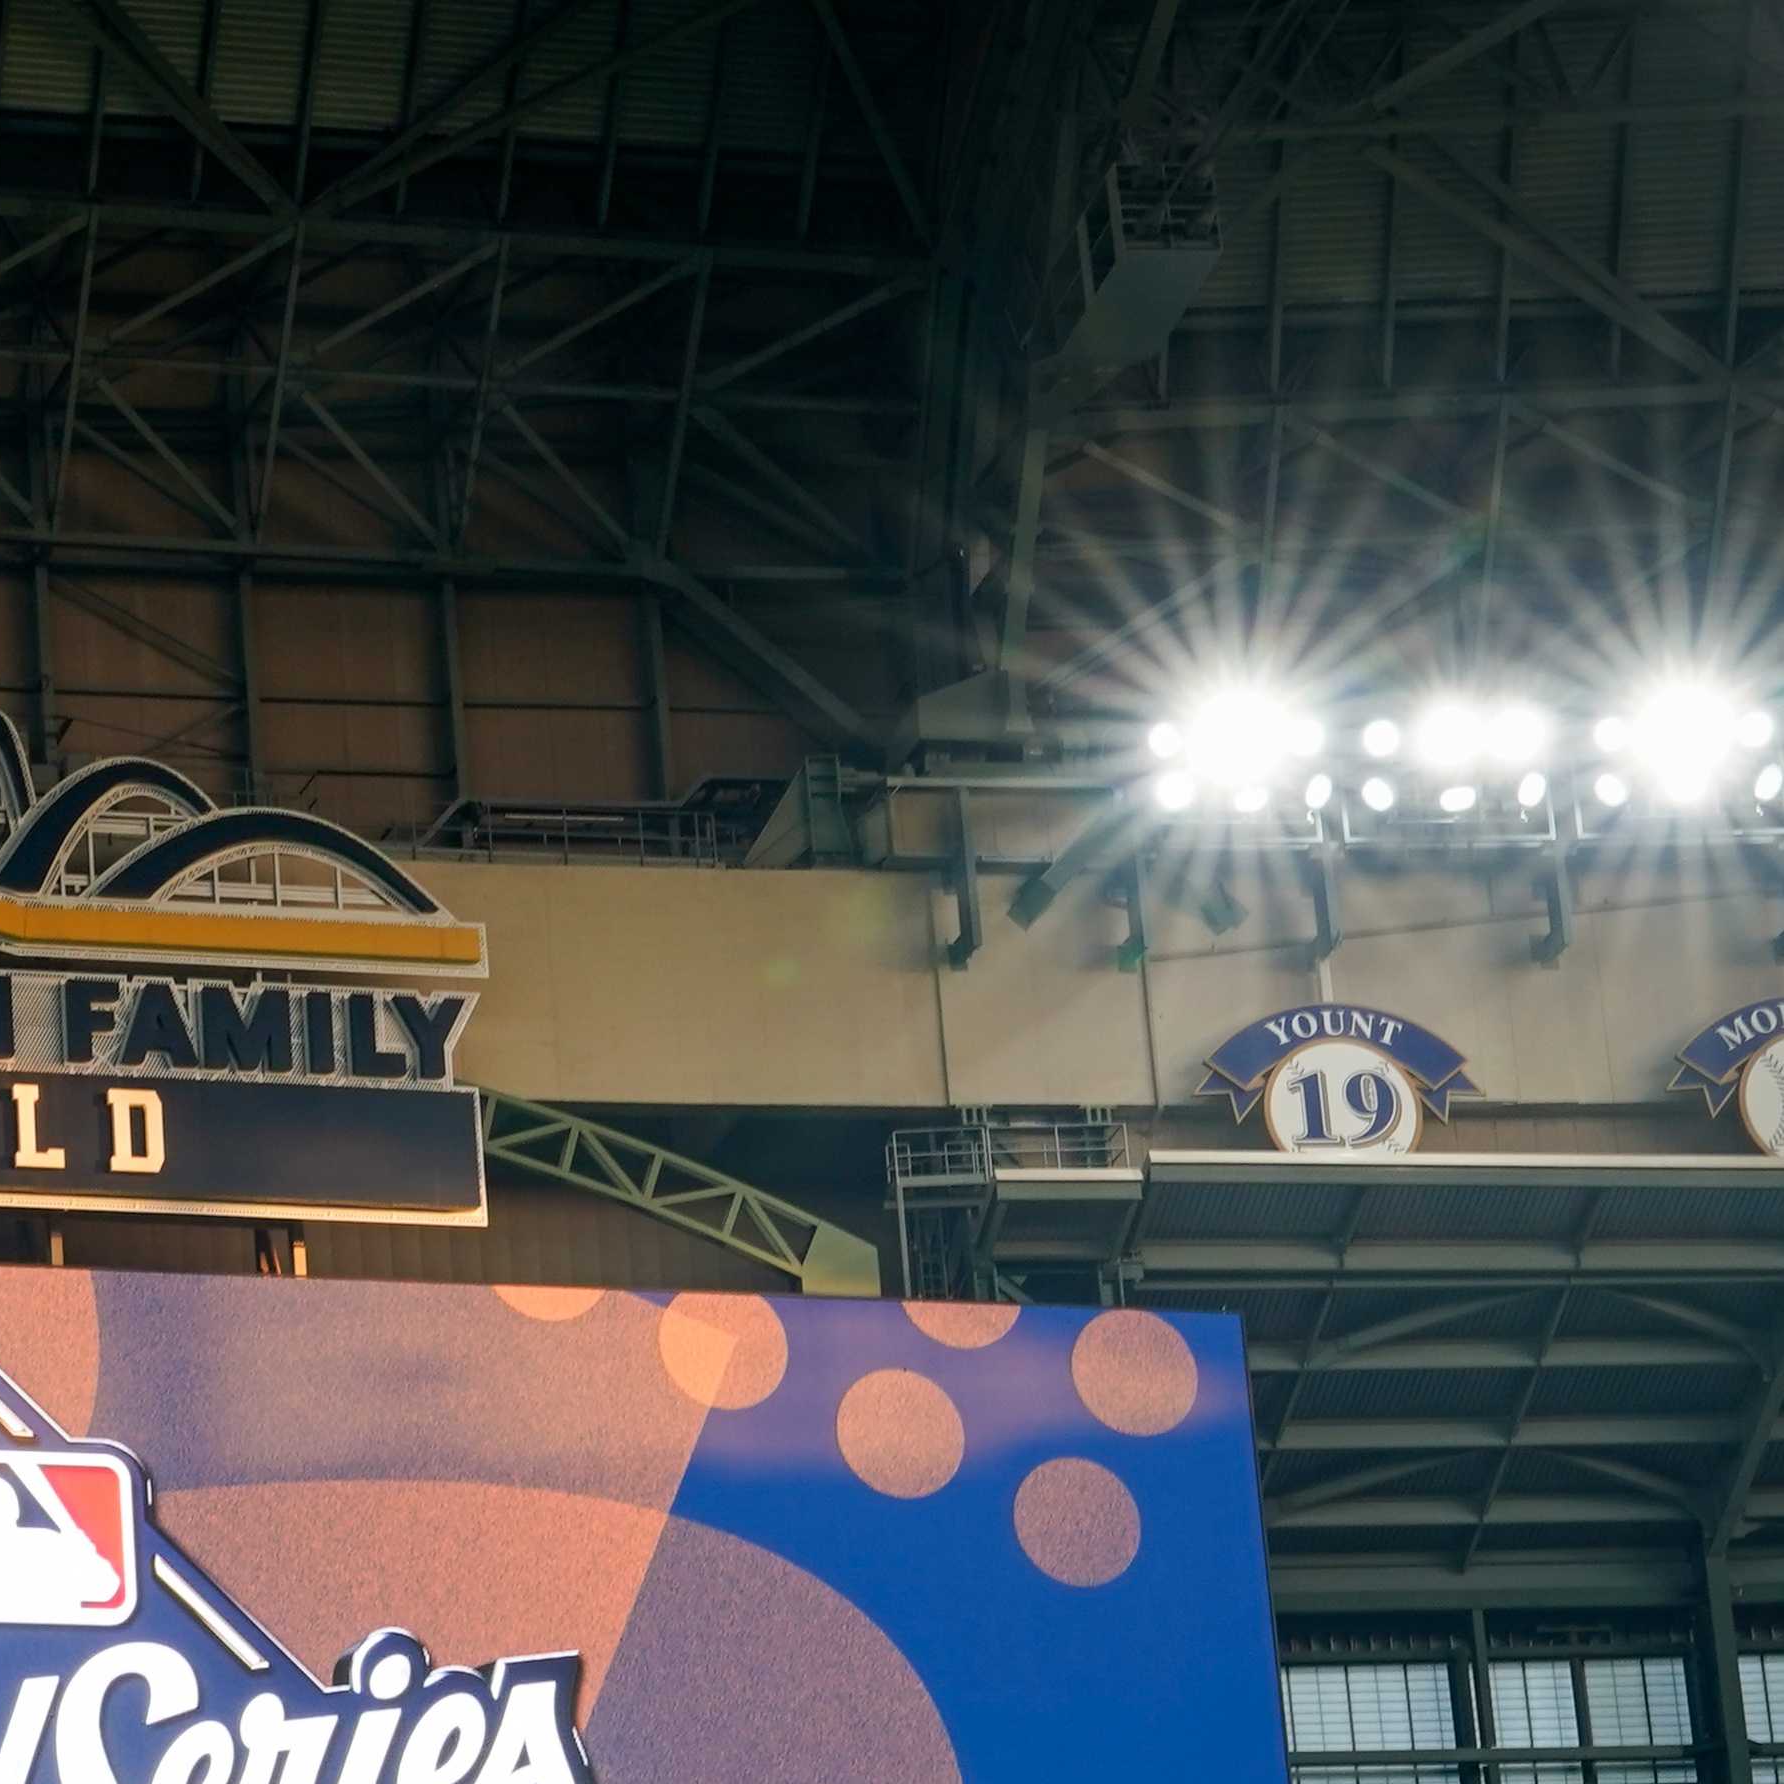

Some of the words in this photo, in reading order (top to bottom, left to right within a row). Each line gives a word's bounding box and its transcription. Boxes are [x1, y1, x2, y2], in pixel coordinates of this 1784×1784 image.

[60, 976, 469, 1082] FAMILY
[1264, 1010, 1403, 1047] YOUNT
[1287, 1069, 1403, 1147] 19
